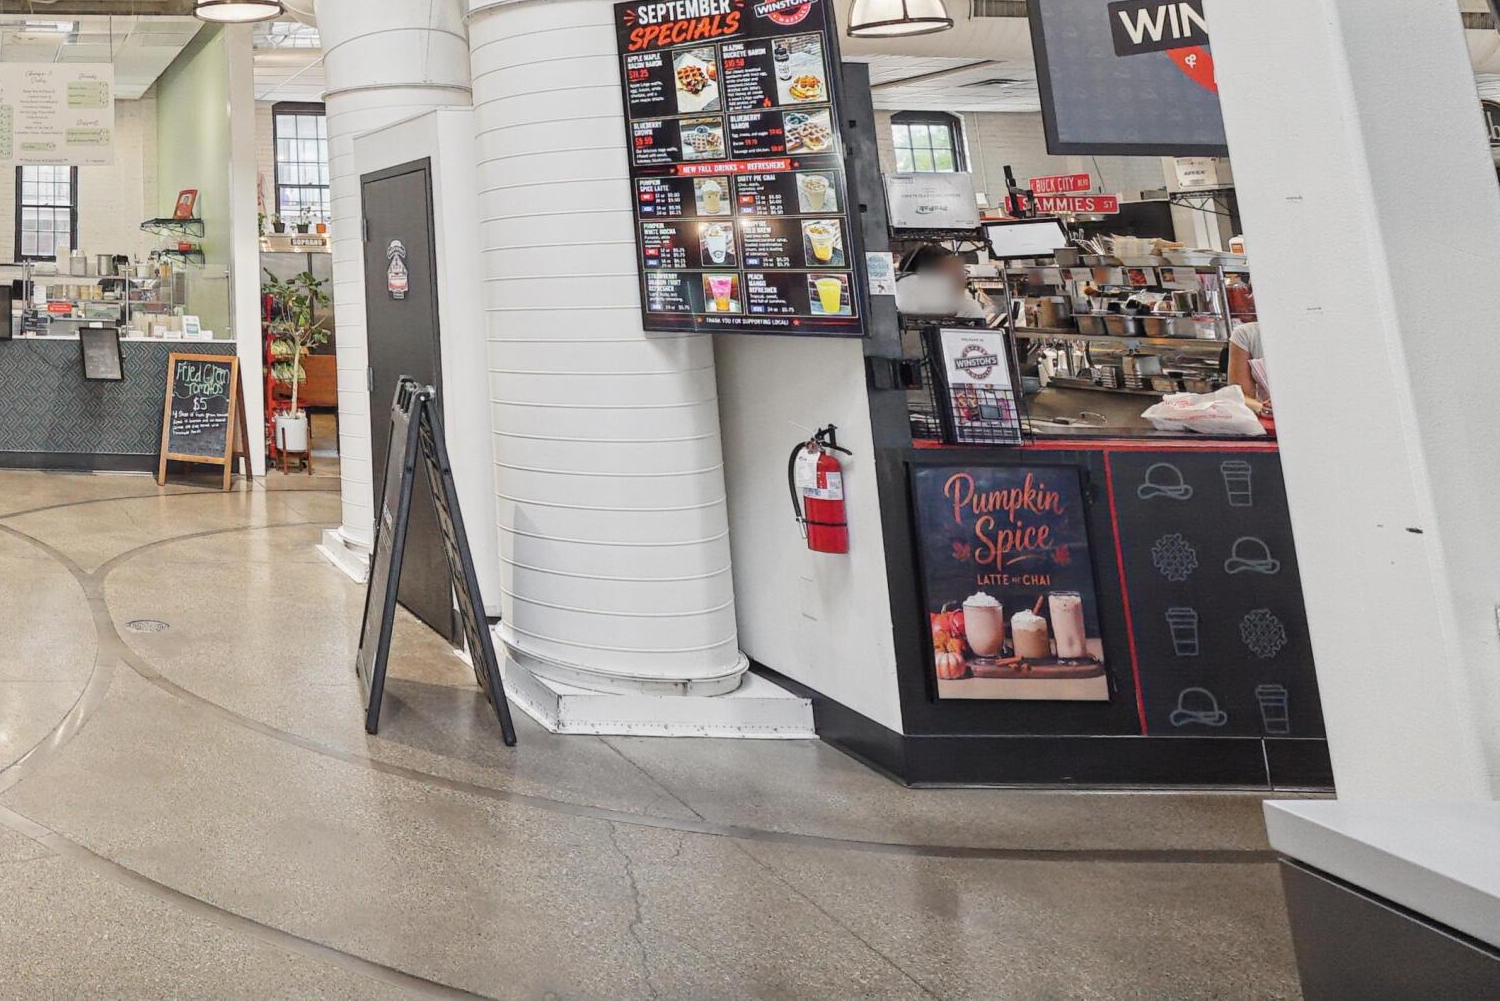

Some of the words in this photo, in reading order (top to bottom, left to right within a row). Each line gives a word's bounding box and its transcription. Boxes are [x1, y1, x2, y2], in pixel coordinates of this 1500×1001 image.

[628, 10, 741, 51] SPECIALS
[682, 165, 697, 174] NEW
[698, 164, 712, 173] FALL
[714, 164, 738, 172] DRINKS
[747, 161, 786, 170] REFRESHERS
[1036, 178, 1056, 192] BUCK
[1058, 177, 1075, 192] CITY
[1023, 197, 1095, 211] SAMMIES
[1103, 200, 1114, 208] ST
[956, 356, 997, 368] WINSTON'S
[176, 361, 202, 383] Fried
[193, 397, 208, 411] $5
[943, 472, 1065, 525] Pumpkin
[974, 515, 1052, 571] Spice
[977, 574, 1009, 586] LATTE
[1022, 574, 1051, 586] CHAI
